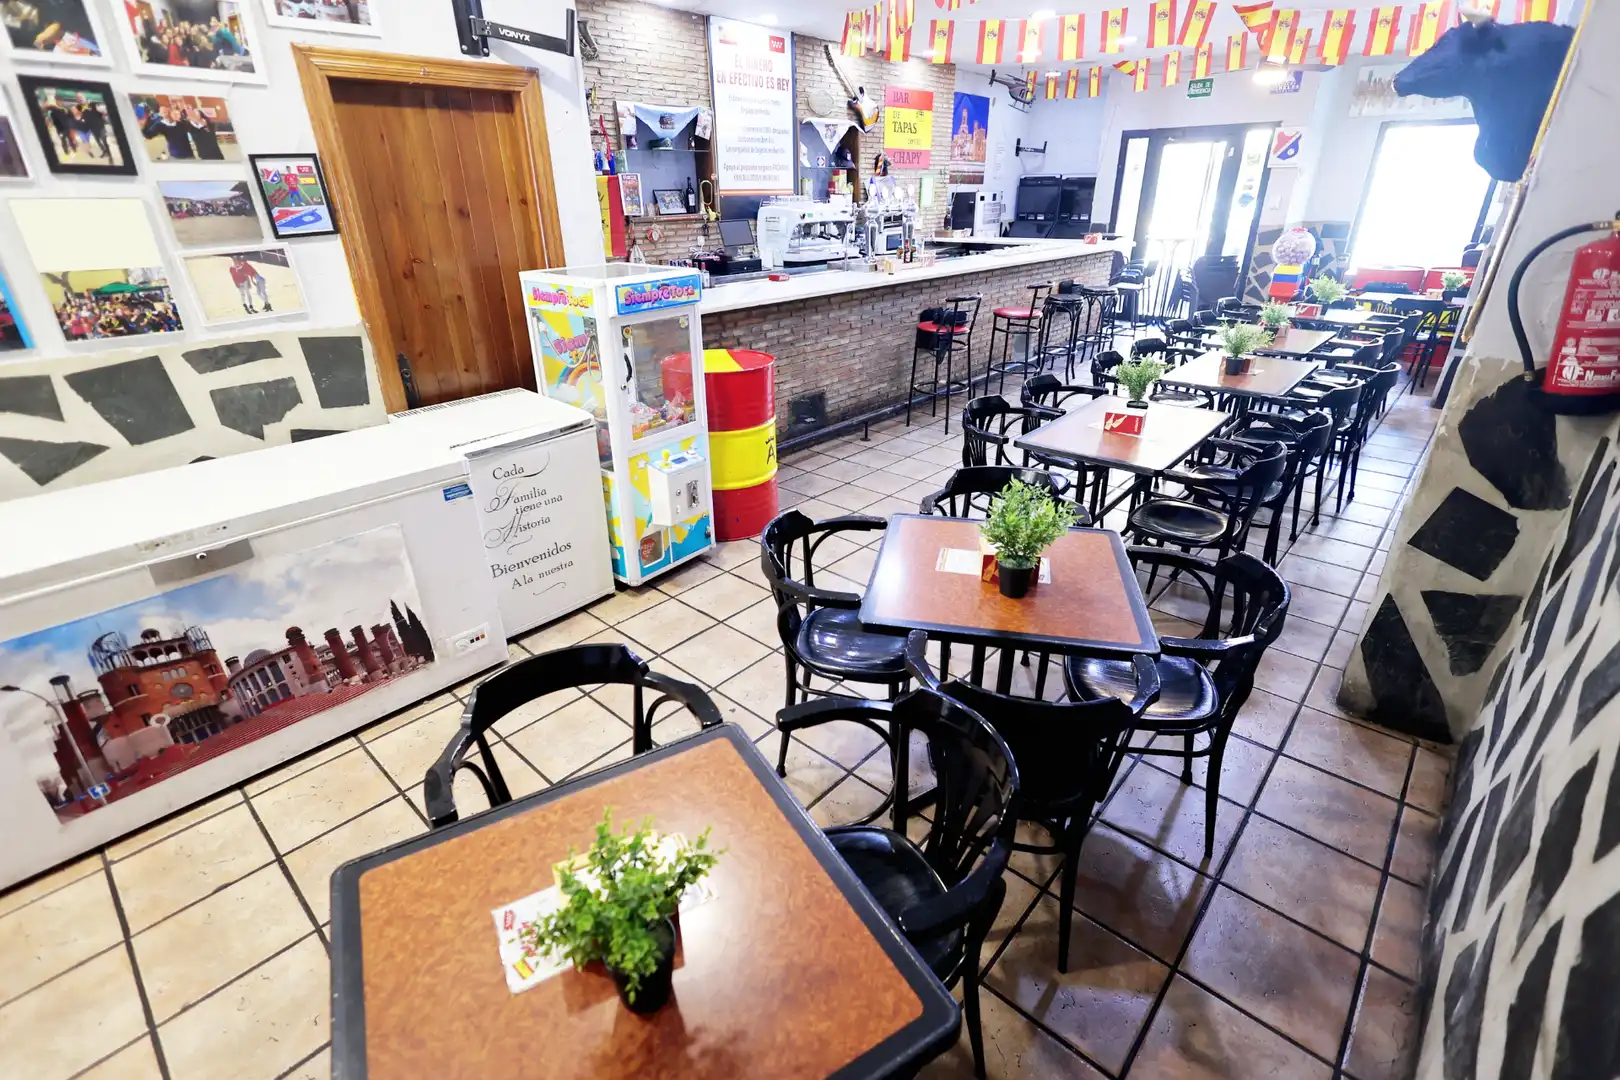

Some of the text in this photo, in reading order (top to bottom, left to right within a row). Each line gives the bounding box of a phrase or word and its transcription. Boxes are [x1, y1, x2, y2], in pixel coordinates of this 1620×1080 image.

[498, 27, 531, 42] VONYX
[729, 72, 764, 88] EFECTIVO
[766, 76, 776, 90] ES
[777, 78, 790, 92] REY
[892, 91, 910, 105] BAR
[892, 121, 918, 135] TAPAS
[893, 151, 922, 165] CHAPY
[532, 286, 568, 306] Siempre
[624, 283, 695, 307] Siempre Toca
[492, 463, 525, 480] Cada
[515, 494, 564, 515] tiene una
[484, 511, 552, 549] Historia
[490, 541, 573, 580] Bienvenidos
[511, 560, 575, 590] A la nuestra
